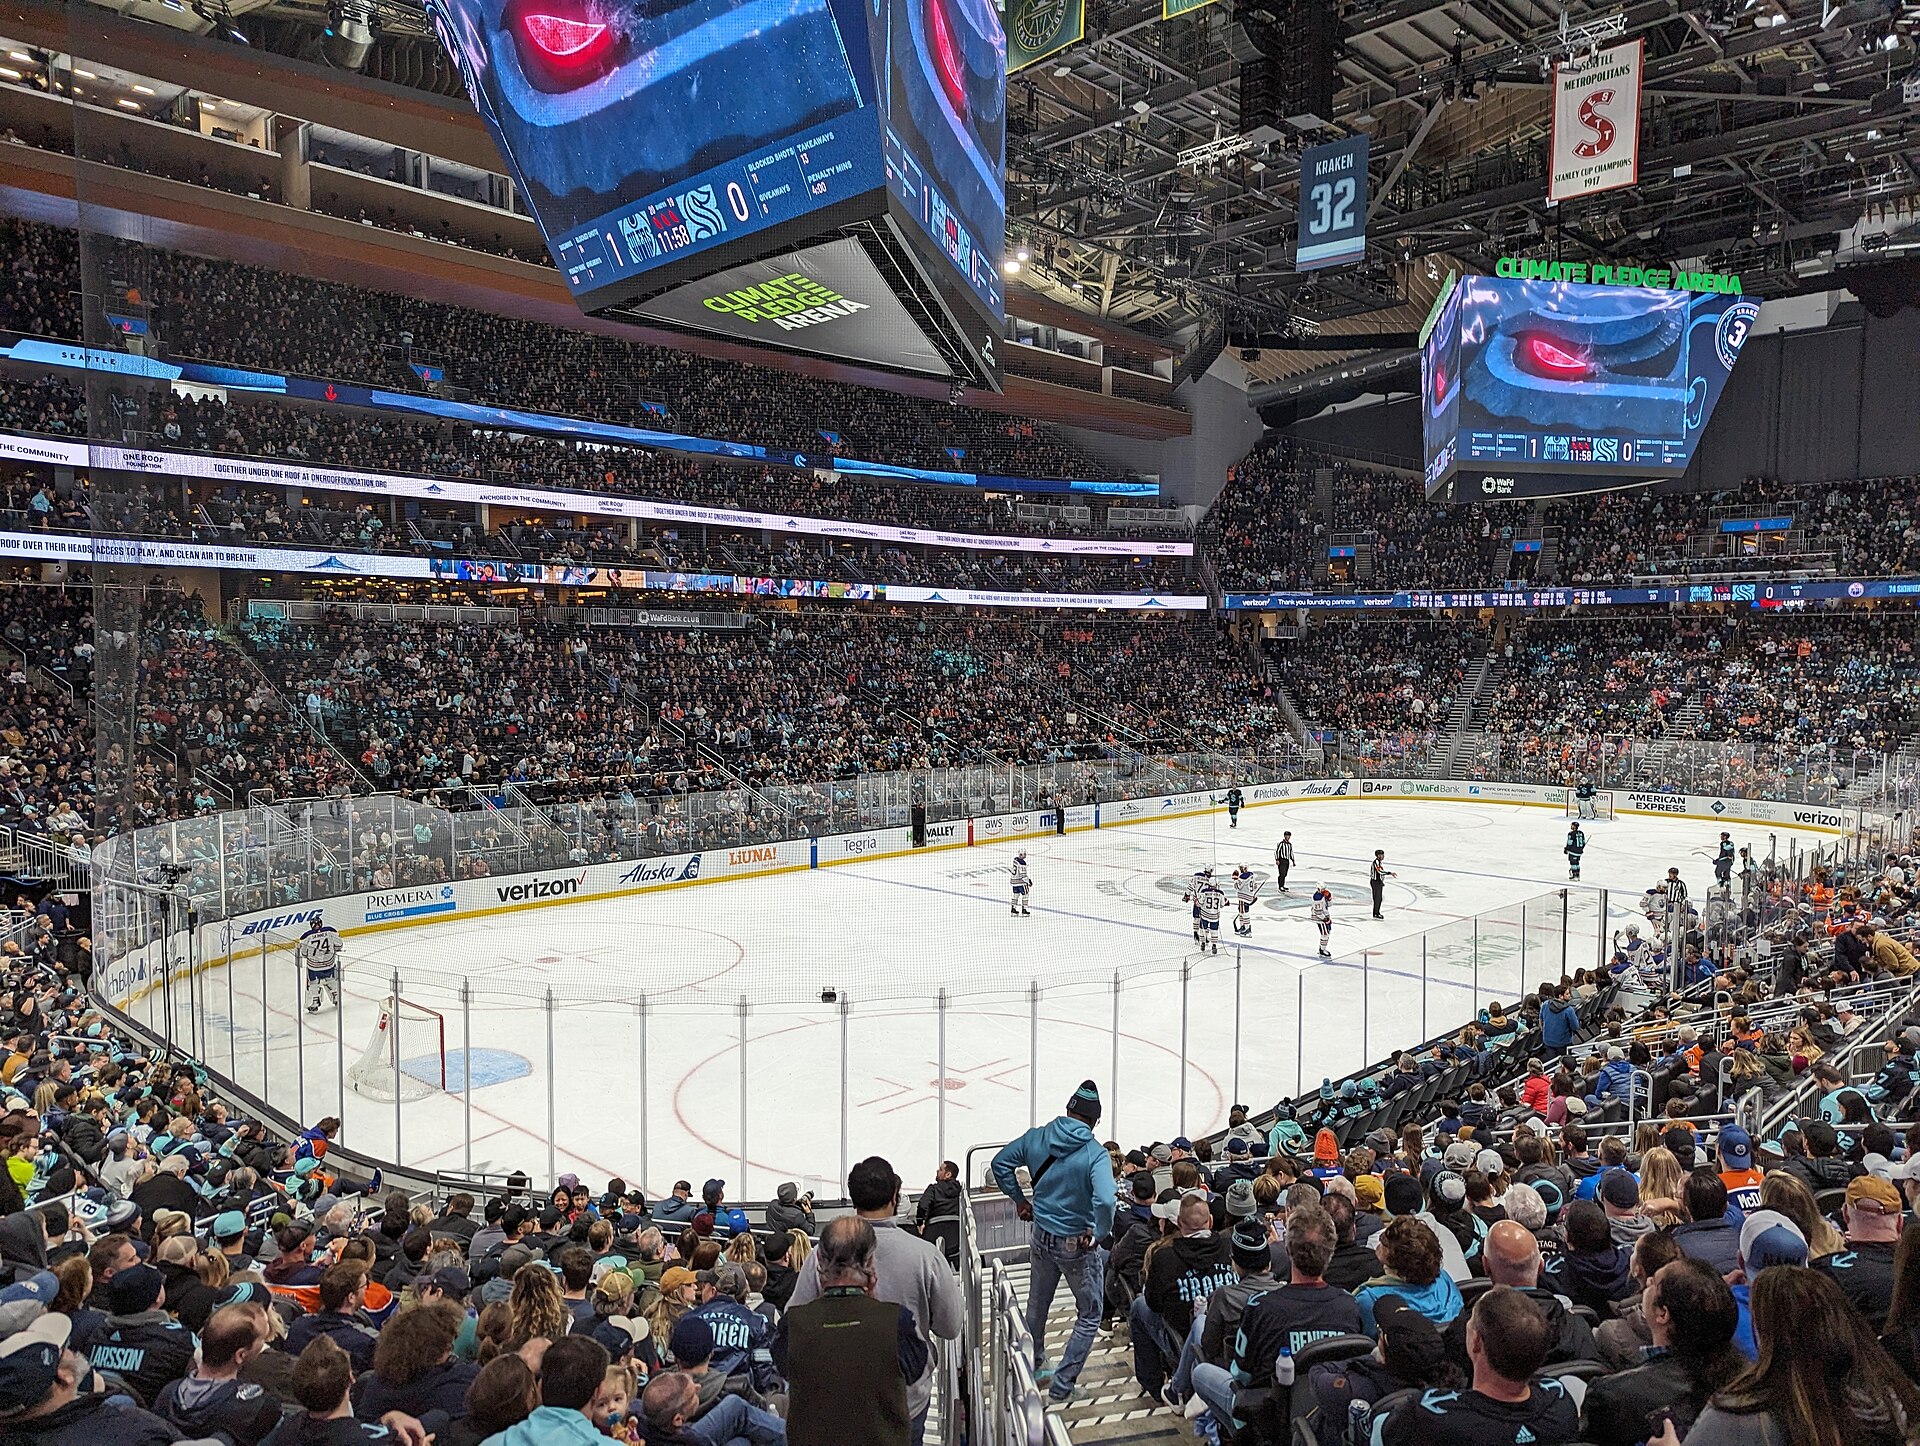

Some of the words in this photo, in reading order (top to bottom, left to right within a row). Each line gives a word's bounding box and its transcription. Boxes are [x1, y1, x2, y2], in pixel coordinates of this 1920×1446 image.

[1564, 64, 1631, 91] METROPOLITANS
[797, 131, 835, 152] TAKEAWAYS
[747, 155, 775, 172] BLOCKED
[774, 147, 796, 161] SHOTS
[800, 152, 810, 165] 13
[1315, 153, 1354, 176] KRAKEN
[807, 167, 835, 184] PENALTY
[835, 160, 853, 174] MINS
[1554, 169, 1580, 184] STANLEY
[1580, 167, 1594, 177] CUP
[1594, 157, 1632, 173] CHAMPIONS
[811, 181, 827, 195] 4:00
[1583, 176, 1601, 188] 1917
[726, 182, 749, 222] 0
[759, 184, 791, 202] GIVEAWAYS
[1309, 176, 1356, 235] 32
[658, 224, 690, 253] 11:58
[606, 232, 624, 267] 1
[1496, 257, 1587, 284] CLIMATE
[1592, 264, 1670, 289] PLEDGE
[1674, 271, 1743, 295] ARENA
[703, 273, 818, 313] CLIMATE
[734, 287, 843, 323] PLEDGE
[773, 299, 871, 331] ARENA
[62, 351, 117, 365] SEATTLE
[0, 443, 15, 452] THE
[17, 446, 70, 462] COMMUNITY
[1530, 438, 1537, 458] 1
[1570, 449, 1592, 461] 11:58
[1623, 442, 1632, 462] 0
[123, 453, 141, 461] ONE
[142, 454, 165, 463] ROOF
[126, 461, 162, 469] FOUNDATION
[214, 463, 247, 475] TOGETHER
[248, 467, 270, 477] UNDER
[271, 469, 284, 479] ONE
[284, 471, 301, 480] ROOF
[302, 474, 310, 482] AT
[1497, 478, 1515, 487] WaFd
[1497, 486, 1512, 494] Bank
[532, 497, 566, 508] COMMUNITY
[653, 507, 674, 515] TOGETHER
[1, 538, 21, 549] ROOF
[22, 540, 43, 551] OVER
[45, 542, 66, 552] THEIR
[96, 546, 124, 556] ACCESS
[126, 547, 136, 557] TO
[138, 549, 158, 558] PLAY,
[159, 550, 175, 560] AND
[177, 551, 200, 560] CLEAN
[201, 552, 214, 561] AIR
[215, 552, 225, 561] TO
[226, 553, 257, 563] BREATHE
[1364, 598, 1390, 606] verizon
[1675, 590, 1680, 601] 1
[1765, 587, 1774, 599] 0
[1243, 599, 1268, 607] verizon
[1306, 598, 1331, 607] founding
[1259, 787, 1290, 799] PitchBook
[1301, 783, 1331, 795] Alaska
[1173, 796, 1201, 806] SYMETRA
[1628, 793, 1687, 805] AMERICAN
[1635, 802, 1687, 813] EXPRESS
[985, 818, 1003, 829] aws
[1012, 815, 1029, 826] aws
[1794, 811, 1850, 828] verizon
[926, 826, 954, 838] VALLEY
[843, 836, 877, 854] Tegria
[729, 847, 777, 866] LiUNA!
[619, 862, 676, 884] Alaska
[497, 877, 578, 902] verizon
[367, 890, 434, 910] PREMERA
[1206, 896, 1220, 910] 93
[242, 909, 324, 936] BOEING
[311, 938, 330, 956] 74
[700, 1312, 743, 1325] EATTLE
[709, 1321, 750, 1349] KEN
[90, 1344, 145, 1372] LARSSON
